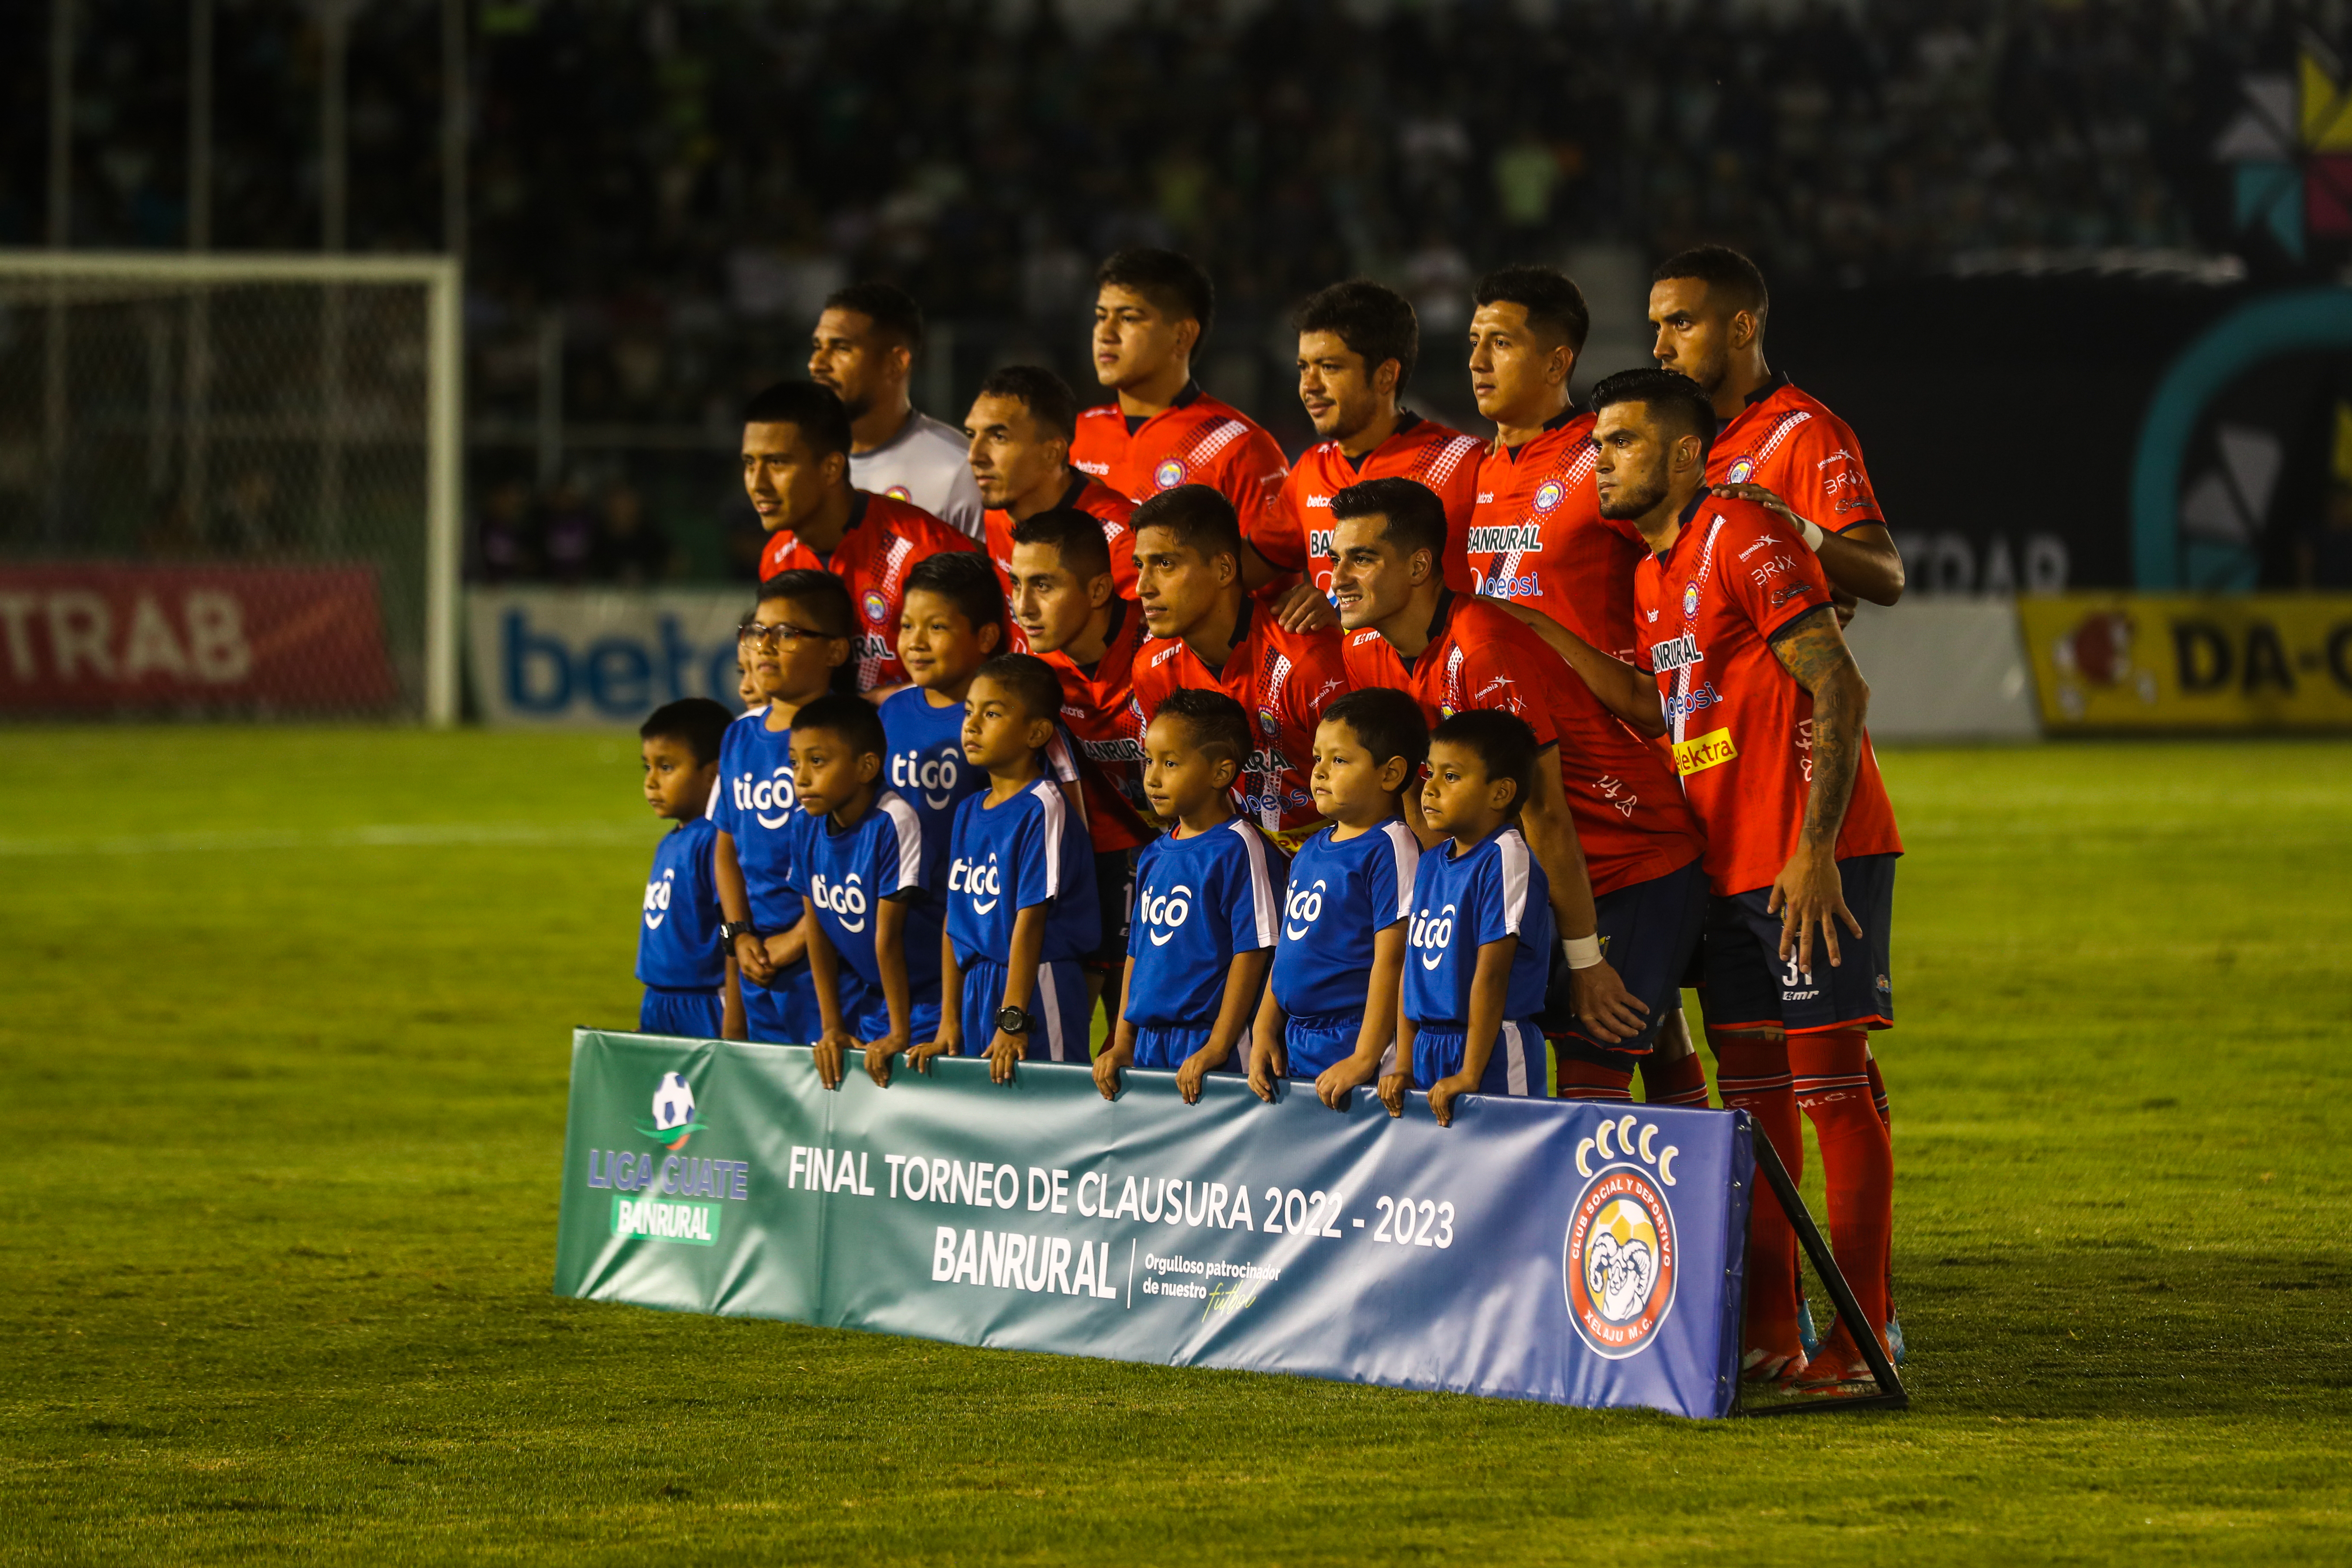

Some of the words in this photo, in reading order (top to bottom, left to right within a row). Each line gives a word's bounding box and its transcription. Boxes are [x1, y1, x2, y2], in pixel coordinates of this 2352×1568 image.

[1667, 682, 1719, 724] pepsi
[588, 1149, 654, 1191] LIGA
[662, 1154, 748, 1200] GUATE
[788, 1146, 875, 1196] FINAL
[885, 1154, 1019, 1210] TORNEO
[1027, 1167, 1069, 1214] DE
[1077, 1171, 1254, 1232] CLAUSURA
[1263, 1187, 1342, 1238] 2022
[1374, 1195, 1456, 1249] 2023
[617, 1200, 711, 1241] BANRURAL
[1572, 1216, 1588, 1259] CLUB
[1586, 1179, 1623, 1214] SOCIAL
[1626, 1178, 1634, 1191] Y
[1636, 1180, 1670, 1267] DEPORTIVO
[932, 1226, 1117, 1299] BANRURAL
[1145, 1253, 1204, 1276] Orgulloso
[1205, 1260, 1281, 1281] patrocinador
[1143, 1277, 1159, 1295] de
[1161, 1282, 1207, 1299] nuestro
[1584, 1309, 1624, 1343] XELAJU
